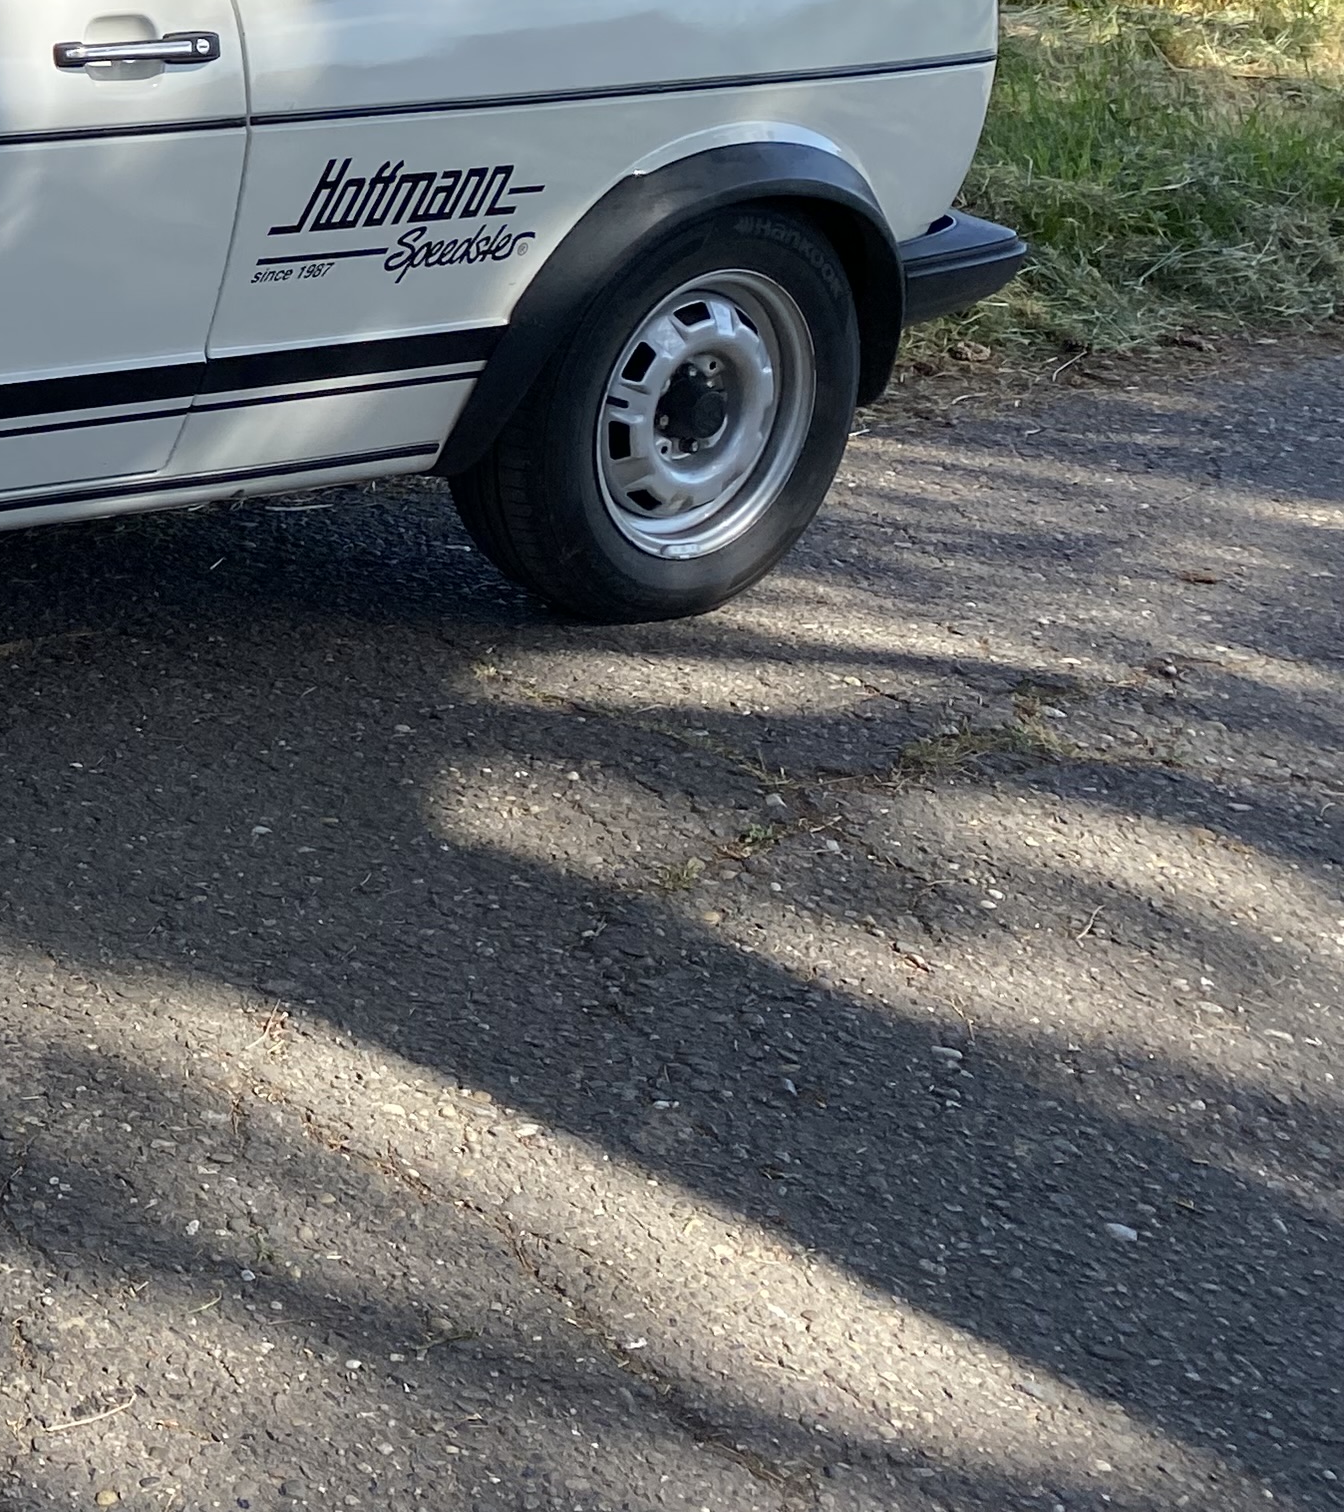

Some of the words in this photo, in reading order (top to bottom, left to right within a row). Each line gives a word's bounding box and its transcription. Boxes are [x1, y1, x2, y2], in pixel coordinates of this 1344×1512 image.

[250, 268, 293, 284] since
[296, 262, 334, 281] 1987
[383, 225, 536, 283] Speedster
